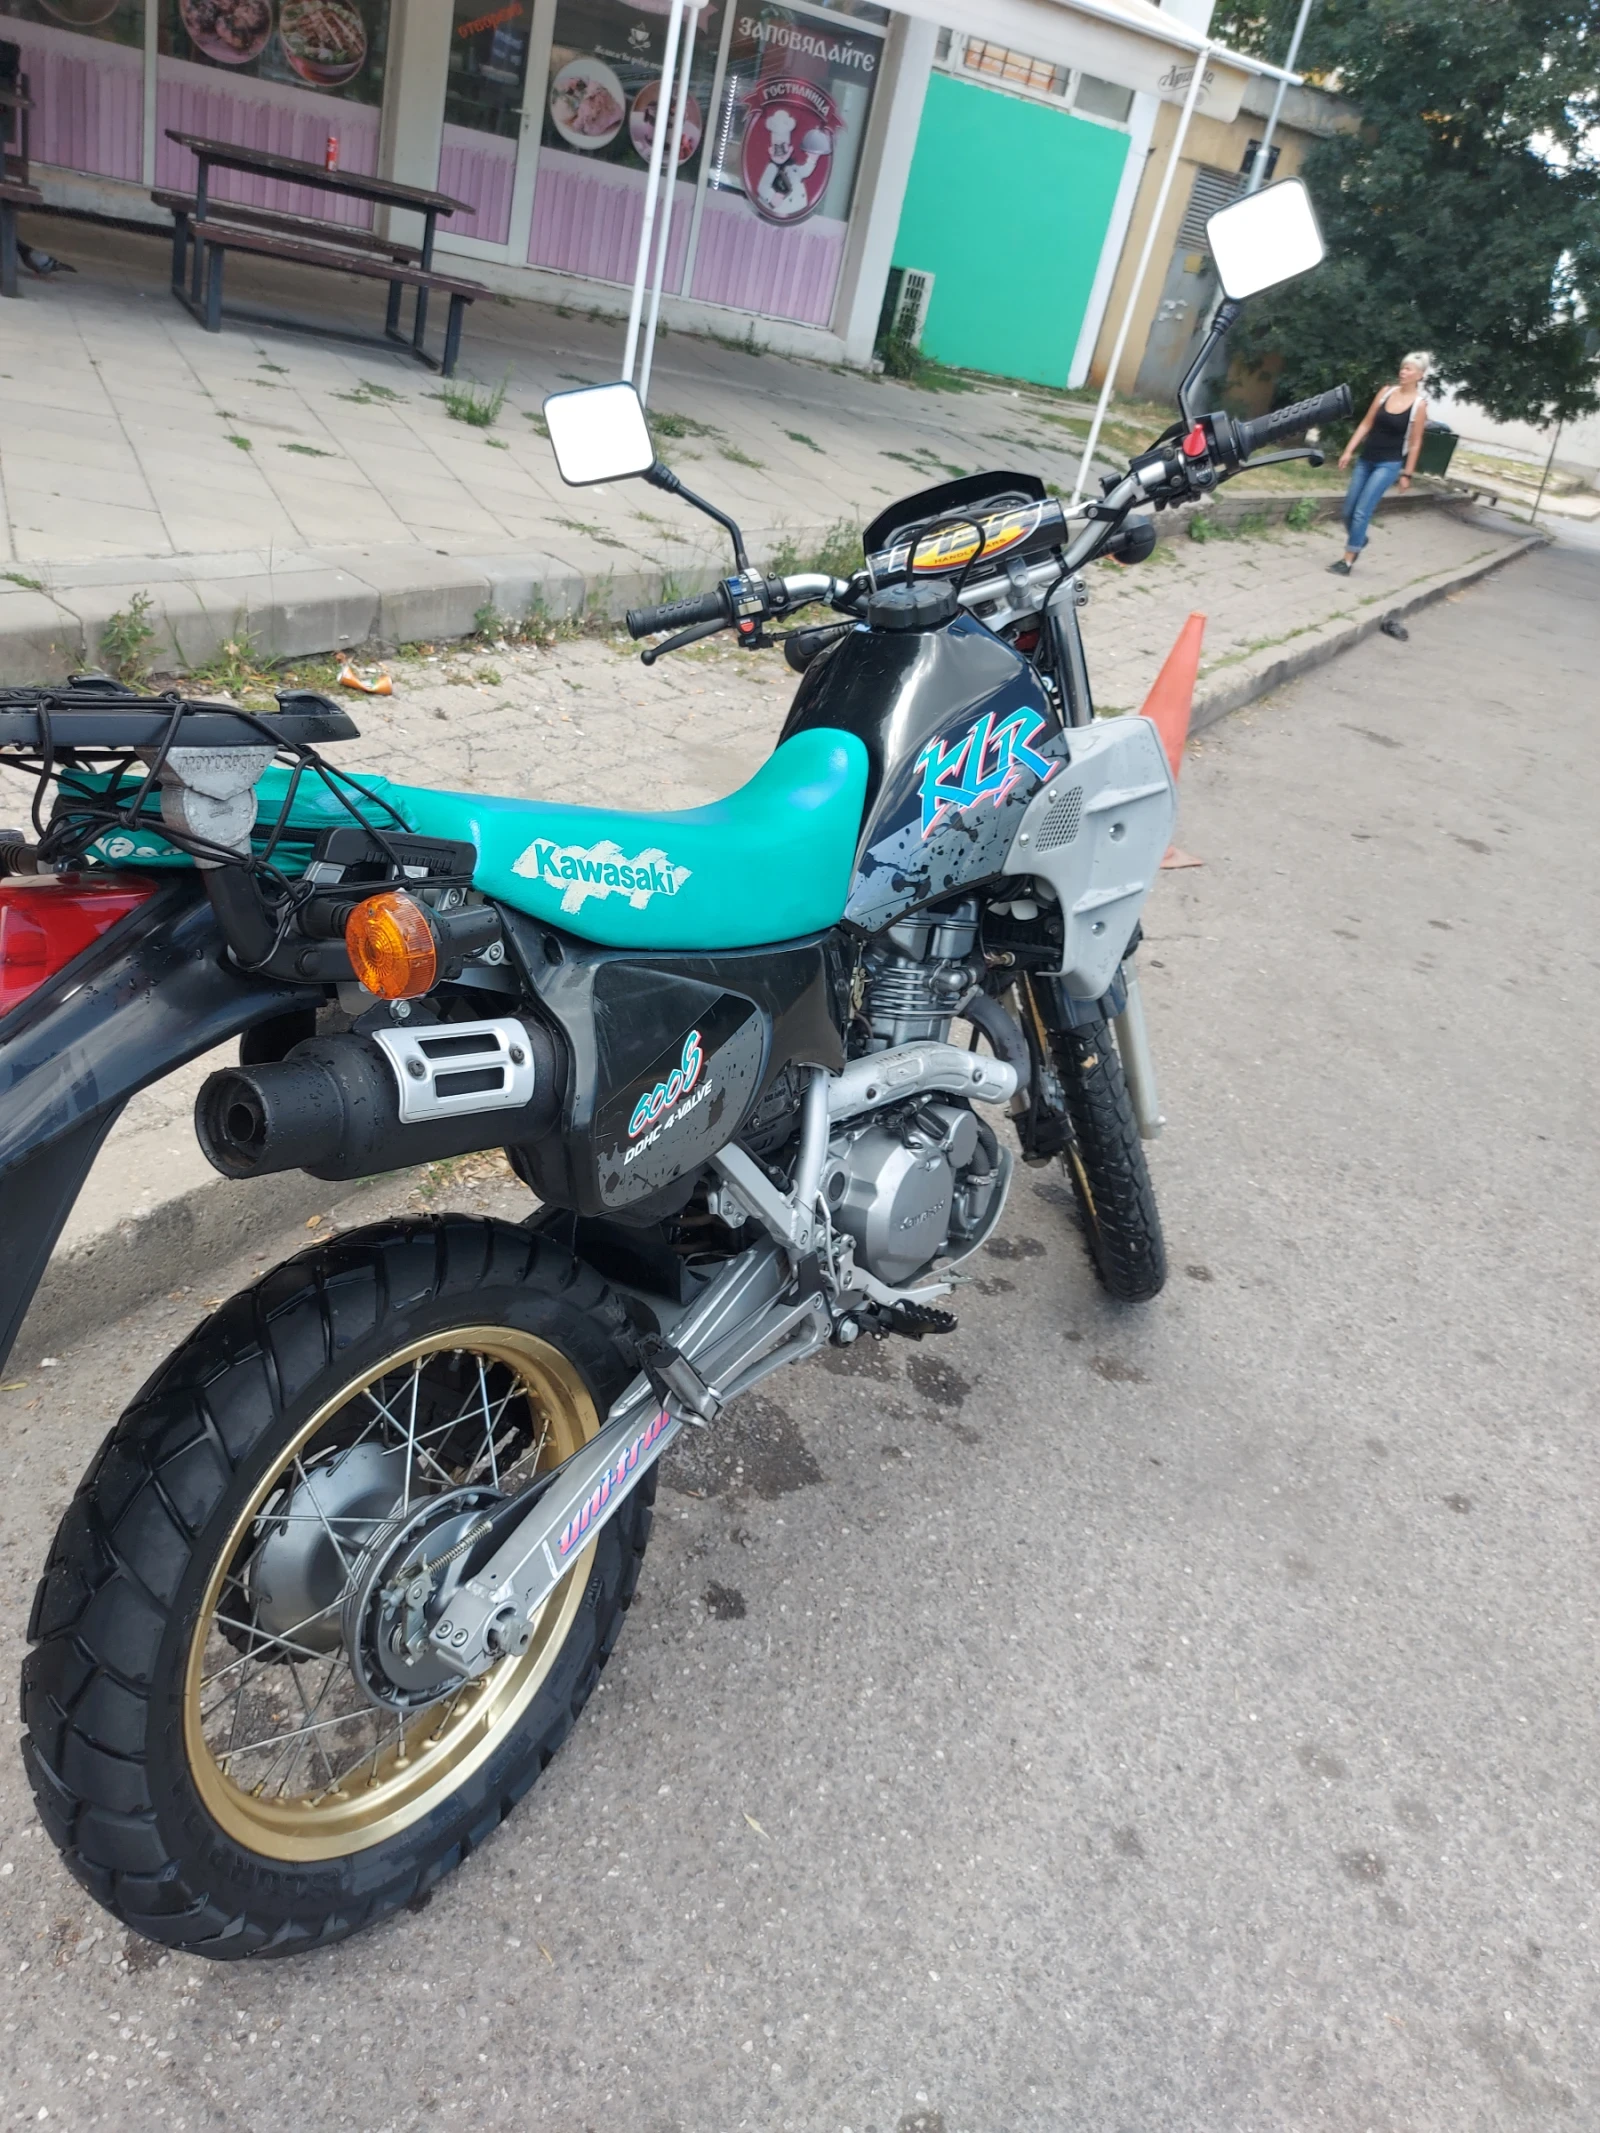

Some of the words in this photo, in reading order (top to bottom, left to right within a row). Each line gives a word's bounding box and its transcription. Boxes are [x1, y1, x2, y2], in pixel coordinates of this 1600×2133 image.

[762, 82, 830, 117] ГОСТИЛНИЦА
[913, 706, 1060, 841] KLR
[534, 843, 675, 894] Kawasaki
[623, 1124, 662, 1166] DOHC
[664, 1079, 713, 1130] 4-VALVE
[628, 1030, 703, 1139] 600S
